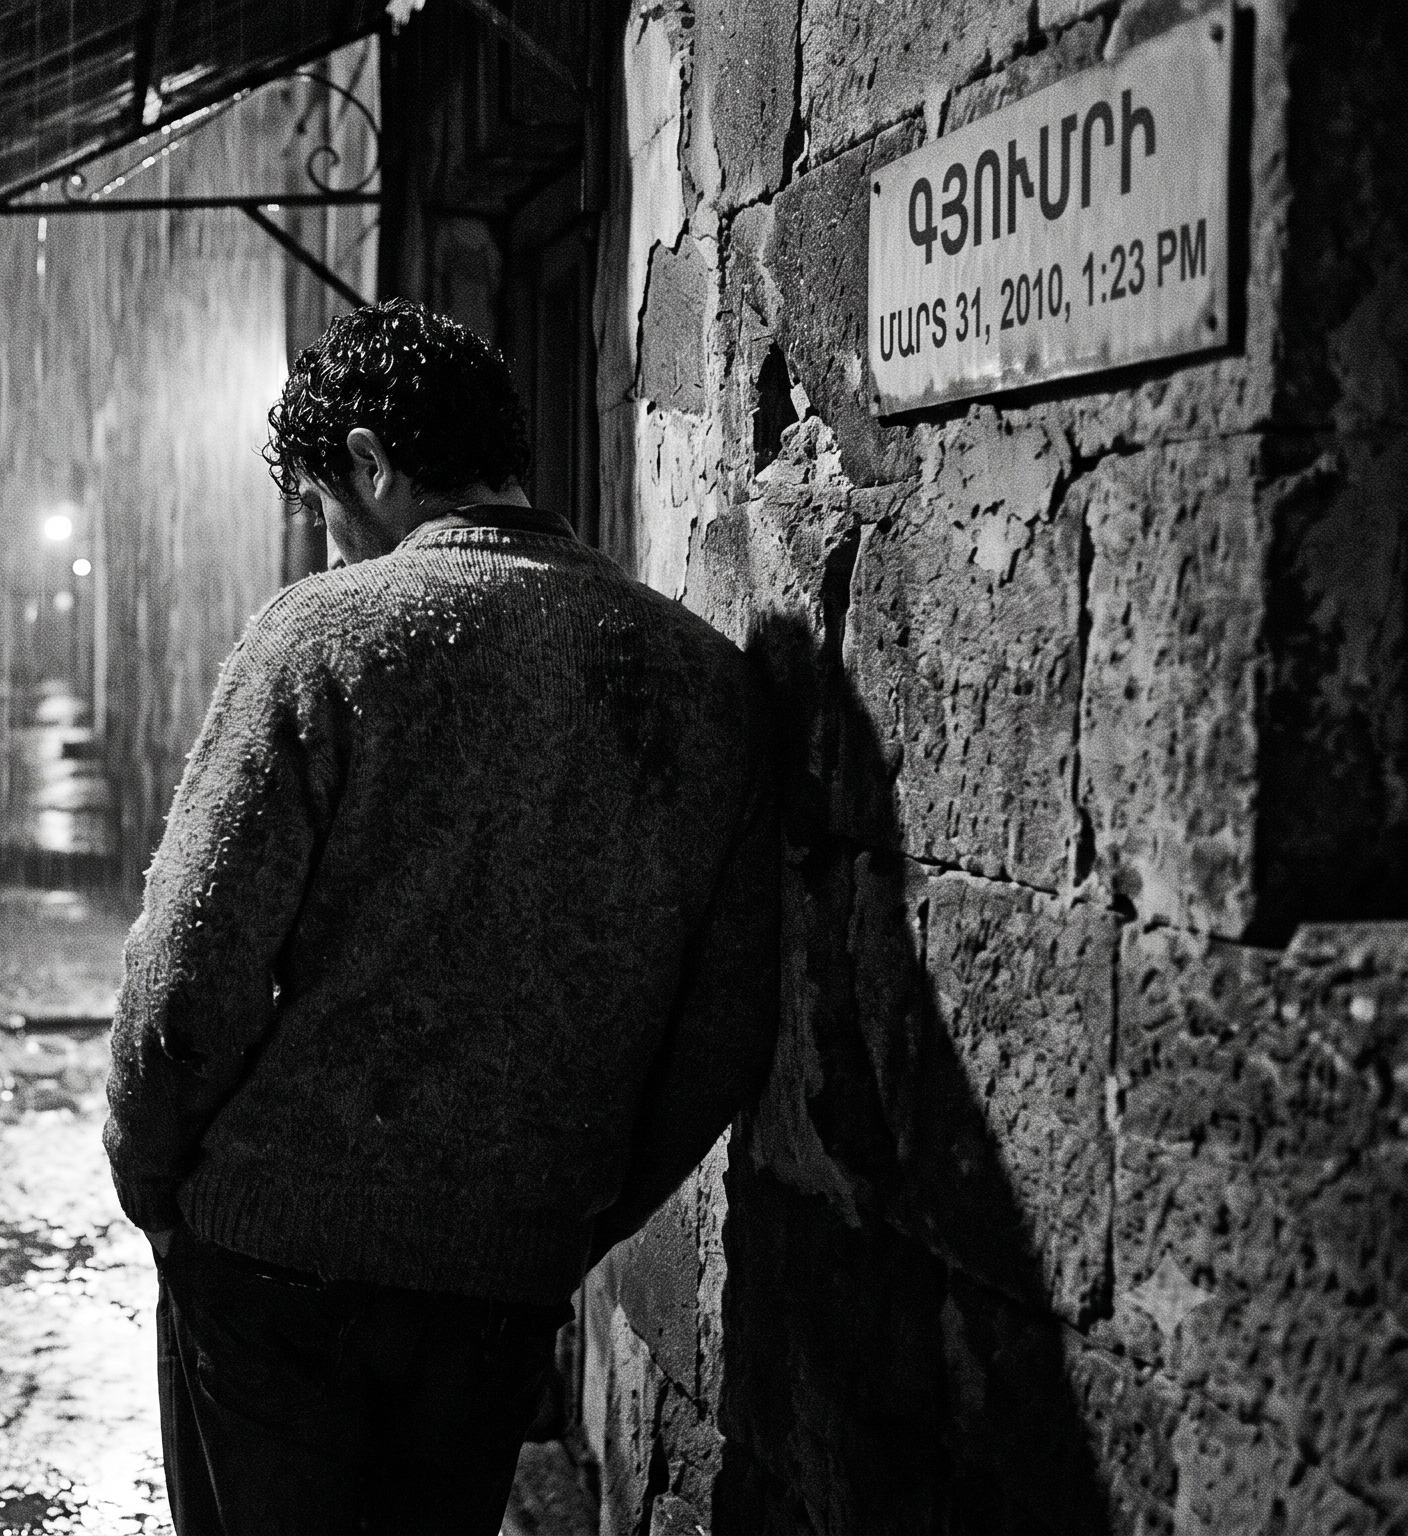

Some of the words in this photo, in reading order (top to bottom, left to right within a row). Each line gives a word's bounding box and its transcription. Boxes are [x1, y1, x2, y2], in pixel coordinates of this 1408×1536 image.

[908, 89, 1156, 265] ԳՅՈՒՄՐԻ
[880, 298, 947, 362] ՄԱՐՏ
[955, 286, 991, 346] 31,
[1000, 263, 1071, 331] 2010,
[1081, 239, 1146, 307] 1:23
[1156, 217, 1207, 288] PM
